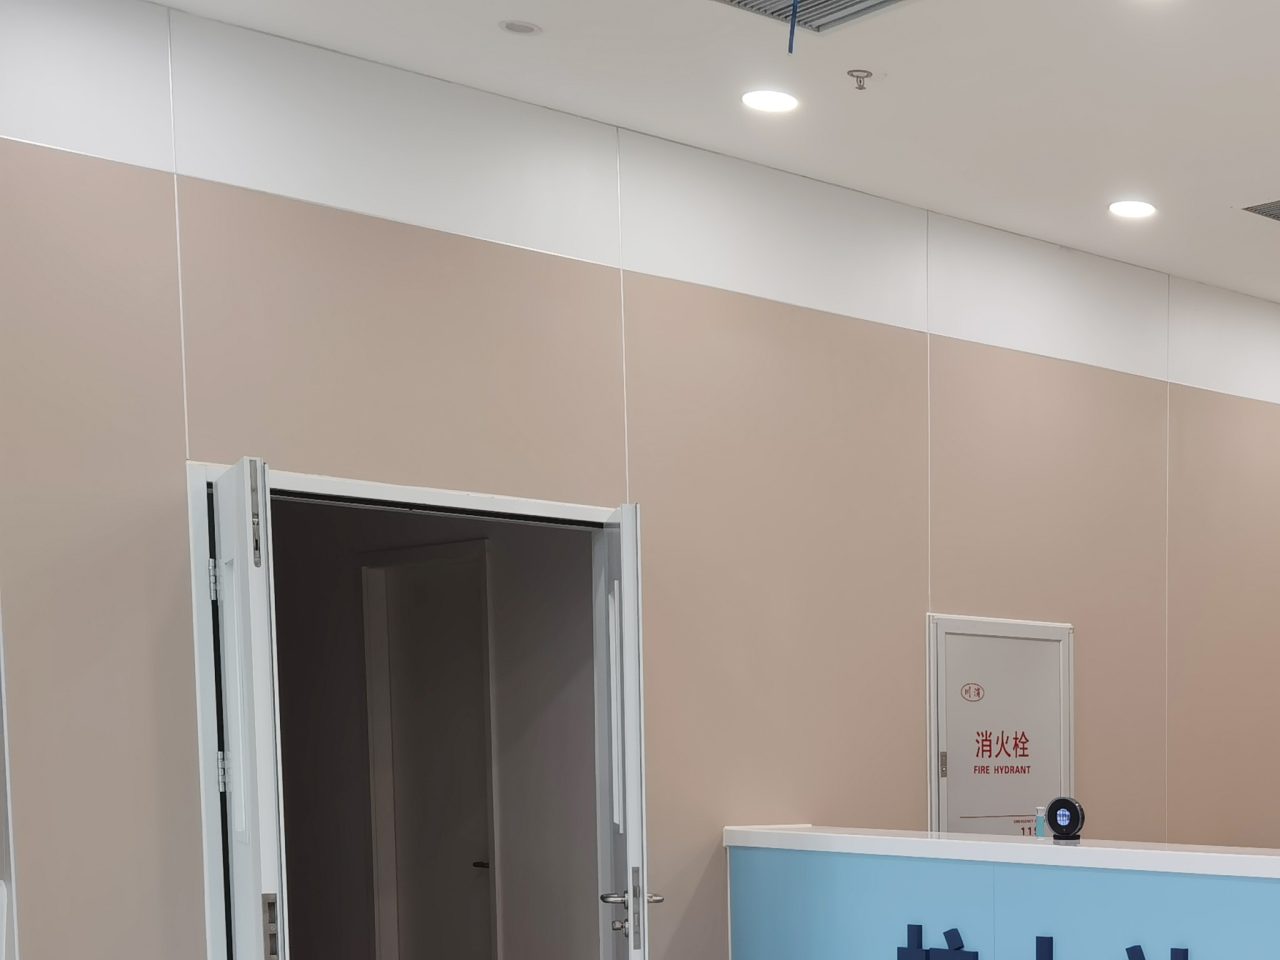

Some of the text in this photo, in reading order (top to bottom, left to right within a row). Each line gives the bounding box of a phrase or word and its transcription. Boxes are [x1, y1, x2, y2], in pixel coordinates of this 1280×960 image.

[975, 729, 1029, 758] 消火栓
[973, 765, 1031, 774] FIRE HYDRANT
[1021, 826, 1037, 836] 11
